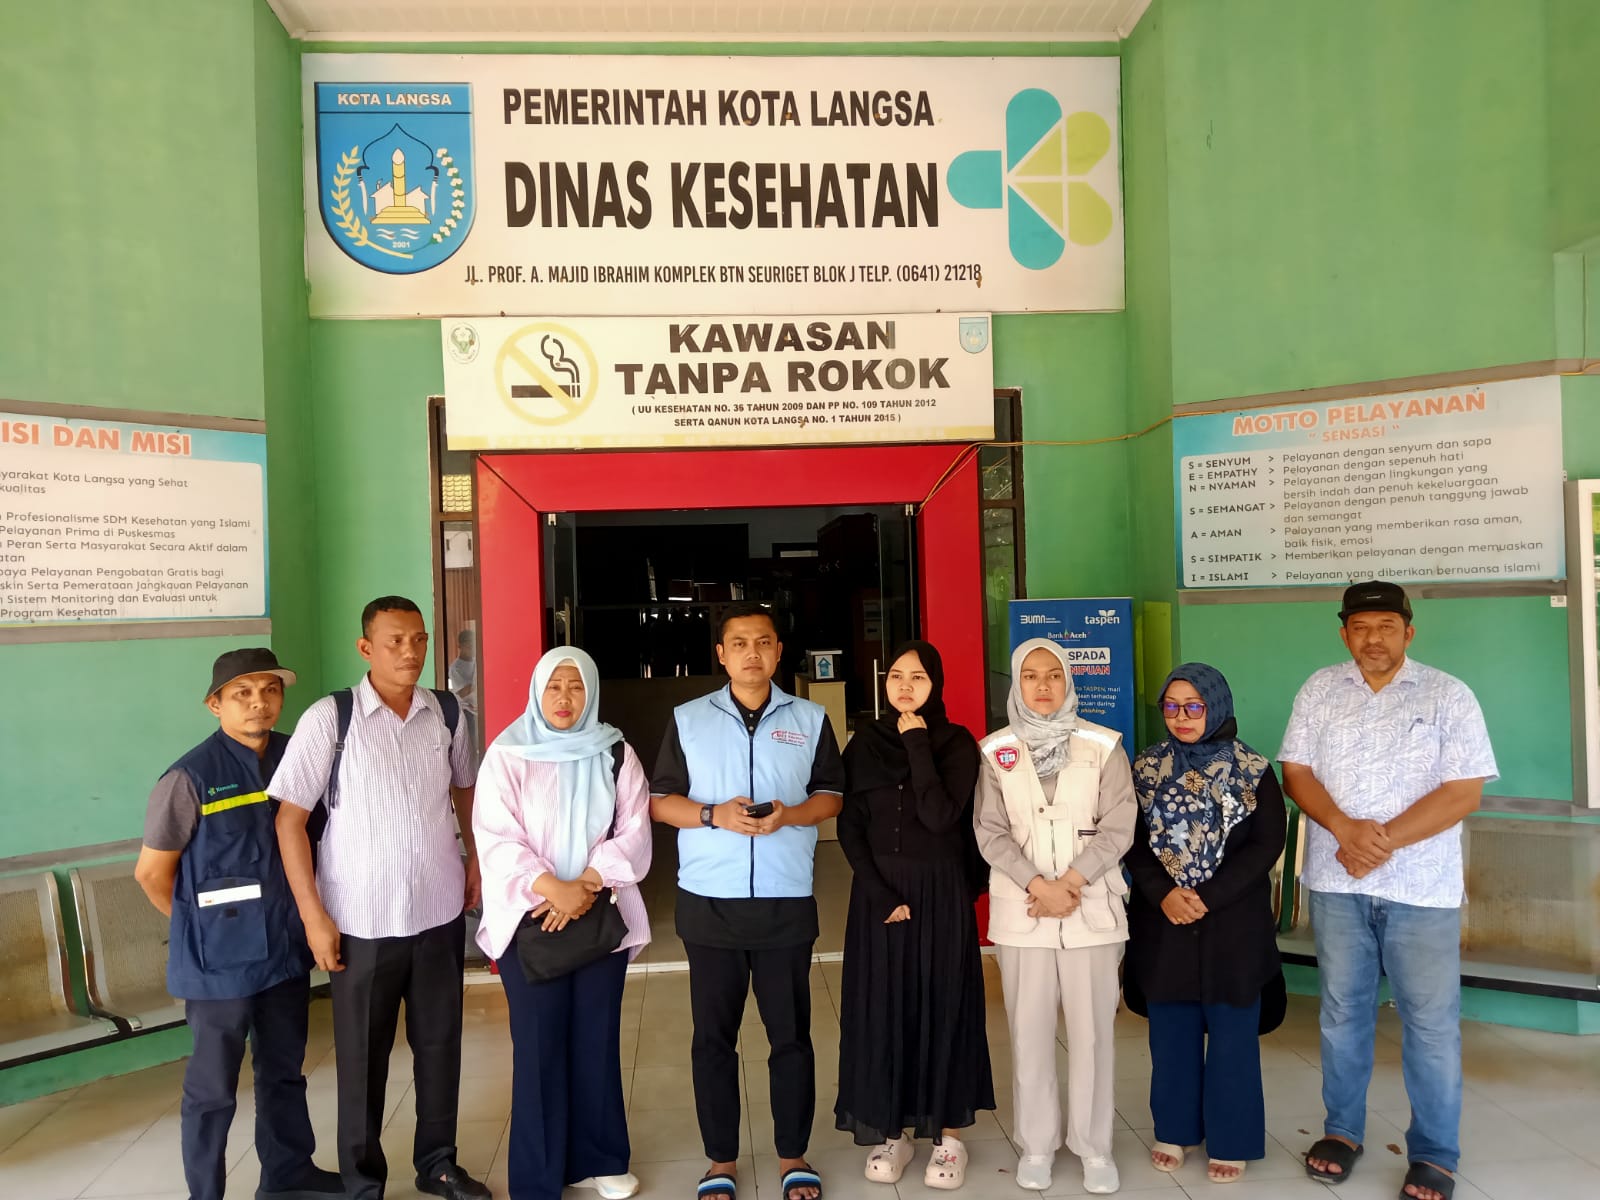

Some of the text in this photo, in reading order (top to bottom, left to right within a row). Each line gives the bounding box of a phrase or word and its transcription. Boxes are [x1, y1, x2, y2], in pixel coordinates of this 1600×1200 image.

[337, 93, 452, 106] KOTA LANGSA
[503, 88, 935, 127] PEMERINTAH KOTA LANGSA
[504, 160, 939, 230] DINAS KESEHATAN
[465, 264, 981, 285] JL. PROF. A. MAJID IBRAHIM KOMPLEK BTN SEURIGET BLOK J TELP. (0641) 21218
[669, 321, 896, 353] KAWASAN
[615, 357, 951, 395] TANPA ROKOK
[638, 406, 652, 414] UU
[655, 405, 712, 414] KESEHATAN
[714, 404, 731, 413] NO.
[747, 403, 780, 412] TAHUN
[782, 402, 804, 411] 2009
[806, 402, 826, 411] DAN
[828, 401, 840, 410] PP
[842, 400, 859, 409] NO.
[861, 400, 878, 409] 109
[880, 399, 912, 408] TAHUN
[915, 399, 936, 408] 2012
[1234, 392, 1485, 435] MOTTO PELAYANAN
[674, 418, 705, 427] SERTA
[708, 417, 741, 427] QANUN
[744, 417, 770, 425] KOTA
[772, 416, 810, 425] LANGSA
[812, 415, 830, 424] NO.
[840, 415, 872, 423] TAHUN
[874, 414, 896, 423] 2015
[2, 421, 190, 456] ISI DAN MISI
[1322, 425, 1386, 442] SENSASI
[1188, 437, 1492, 470] S SENYUM Pelayanan dengan senyum dan sapa
[1189, 451, 1464, 481] E EMPATHY Pelayanan dengan sepenuh hati
[0, 470, 188, 489] yarakat Kota Langsa yang Sehat
[1189, 463, 1488, 493] N NYAMAN Pelayanan dengan lingkungan yang
[1284, 477, 1498, 499] bersih indah dan penuh kekeluargaan
[1190, 486, 1529, 515] S SEMANGAT Pelayanan dengan penuh tanggung jawab
[6, 511, 100, 524] Profesionalisme
[103, 515, 128, 525] SDM
[131, 516, 187, 527] Kesehatan
[190, 518, 216, 529] yang
[219, 518, 251, 529] Islami
[1191, 514, 1522, 539] A AMAN Pelayanan yang memberikan rasa aman,
[1284, 511, 1362, 524] dan semangat
[65, 527, 100, 537] Prima
[103, 528, 114, 537] di
[118, 528, 176, 539] Puskesmas
[1284, 535, 1373, 548] baik fisik, emosi
[7, 539, 42, 549] Peran
[45, 540, 77, 550] Serta
[81, 541, 146, 553] Masyarakat
[149, 542, 185, 552] Secara
[188, 543, 213, 553] Aktif
[216, 543, 248, 553] dalam
[1191, 540, 1544, 563] S SIMPATIK Memberikan pelayanan dengan memuaskan
[31, 567, 93, 578] Pelayanan
[96, 567, 164, 579] Pengobatan
[167, 568, 198, 577] Gratis
[201, 568, 224, 578] bagi
[1191, 561, 1541, 582] I ISLAMI Pelayanan yang diberikan bernuansa islami
[27, 581, 59, 590] Serta
[63, 581, 133, 590] Pemerataan
[136, 580, 193, 592] Jangkauan
[195, 580, 249, 590] Pelayanan
[7, 594, 47, 604] Sistem
[51, 594, 114, 605] Monitoring
[118, 594, 139, 604] dan
[142, 593, 186, 603] Evaluasi
[188, 592, 218, 602] untuk
[0, 607, 117, 620] Program Kesehatan
[1085, 615, 1120, 626] taspen
[1068, 651, 1106, 661] SPADA
[1070, 665, 1110, 675] NIPUAN
